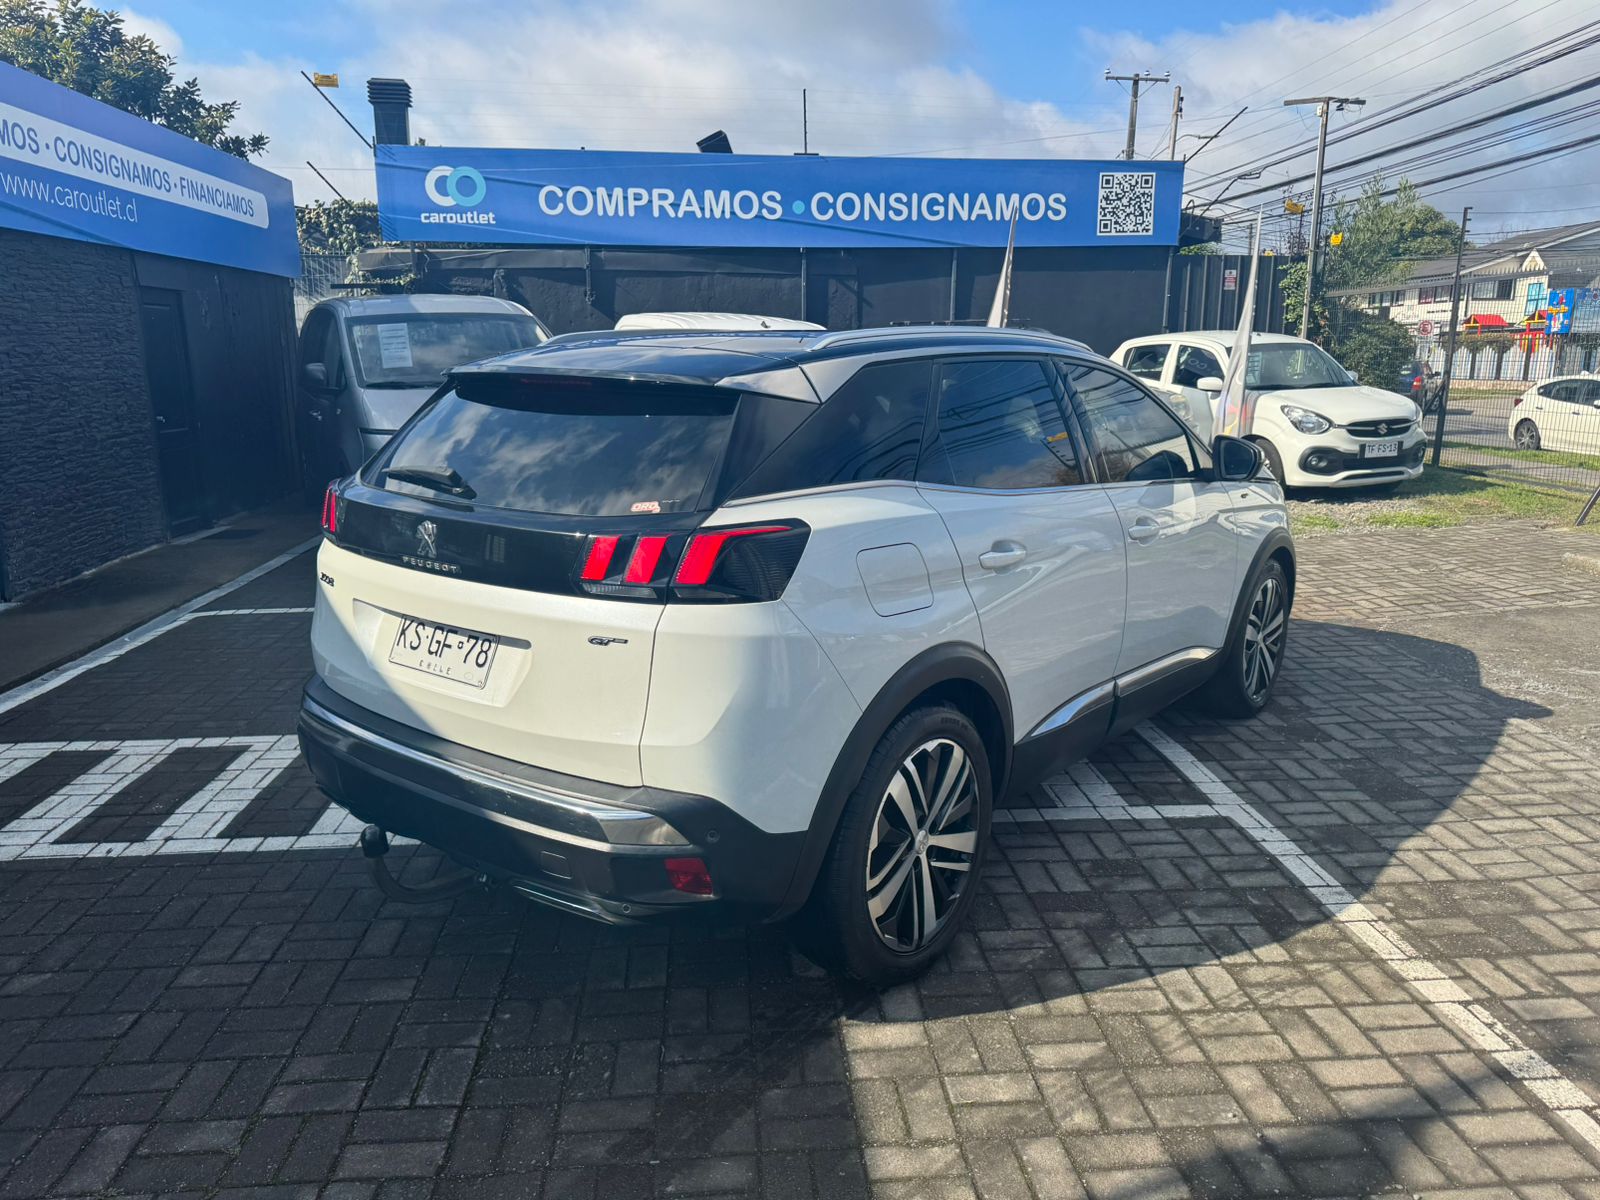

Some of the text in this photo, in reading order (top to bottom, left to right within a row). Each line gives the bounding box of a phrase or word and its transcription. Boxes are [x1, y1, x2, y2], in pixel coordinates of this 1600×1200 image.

[179, 176, 255, 218] FINANCIAMOS
[538, 184, 1068, 222] COMPRAMOS CONSIGNAMOS
[420, 211, 497, 225] caroutlet
[402, 556, 458, 574] PEUGEOT
